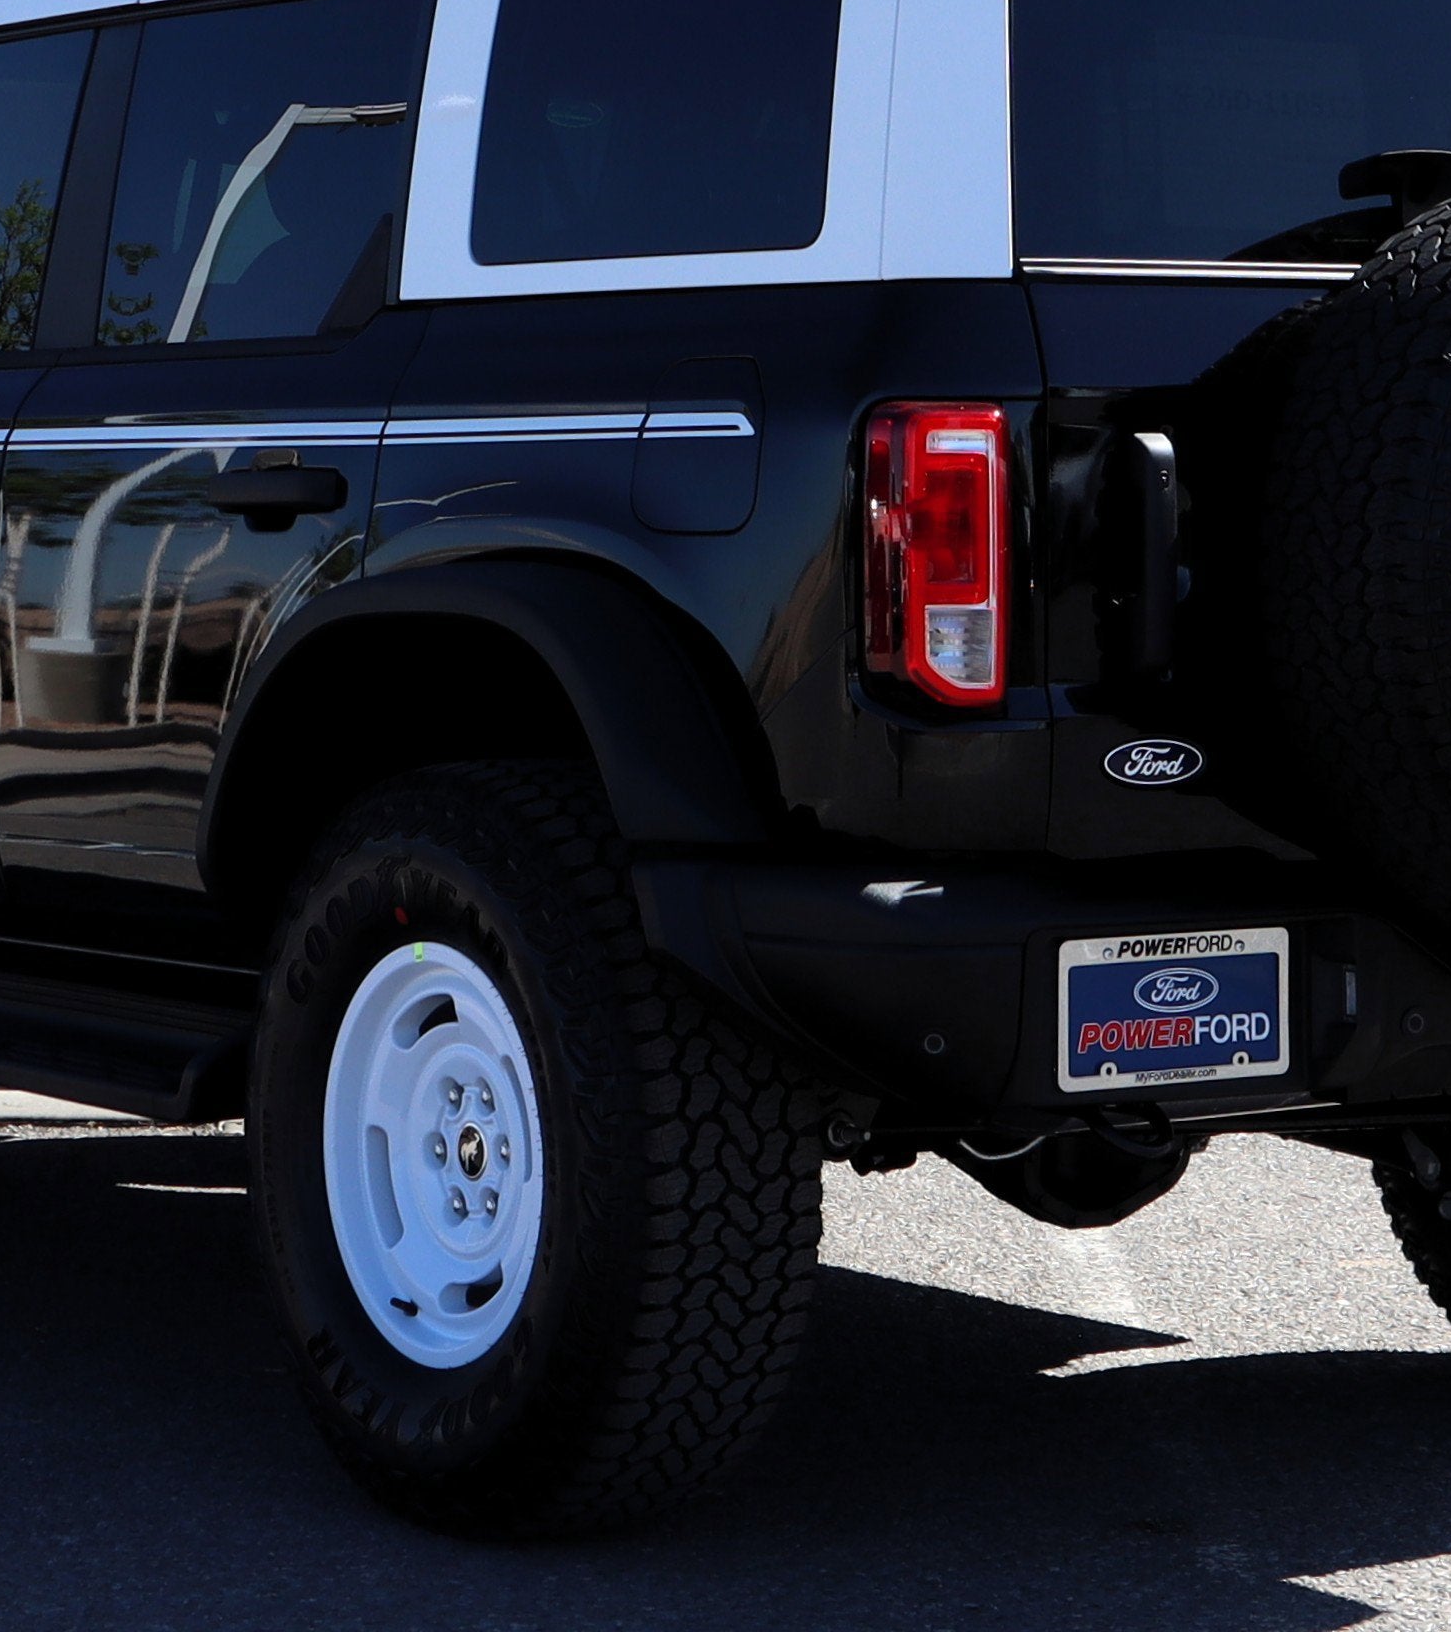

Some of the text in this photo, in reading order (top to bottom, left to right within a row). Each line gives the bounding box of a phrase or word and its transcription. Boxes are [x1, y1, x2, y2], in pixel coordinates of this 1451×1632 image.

[1124, 746, 1184, 777] Ford
[286, 854, 508, 1005] GOODYEAR
[1117, 933, 1233, 959] POWERFORD
[1150, 975, 1200, 1003] Ford
[1077, 1011, 1270, 1054] POWERFORD
[1135, 1067, 1217, 1084] MyFordDealer.com
